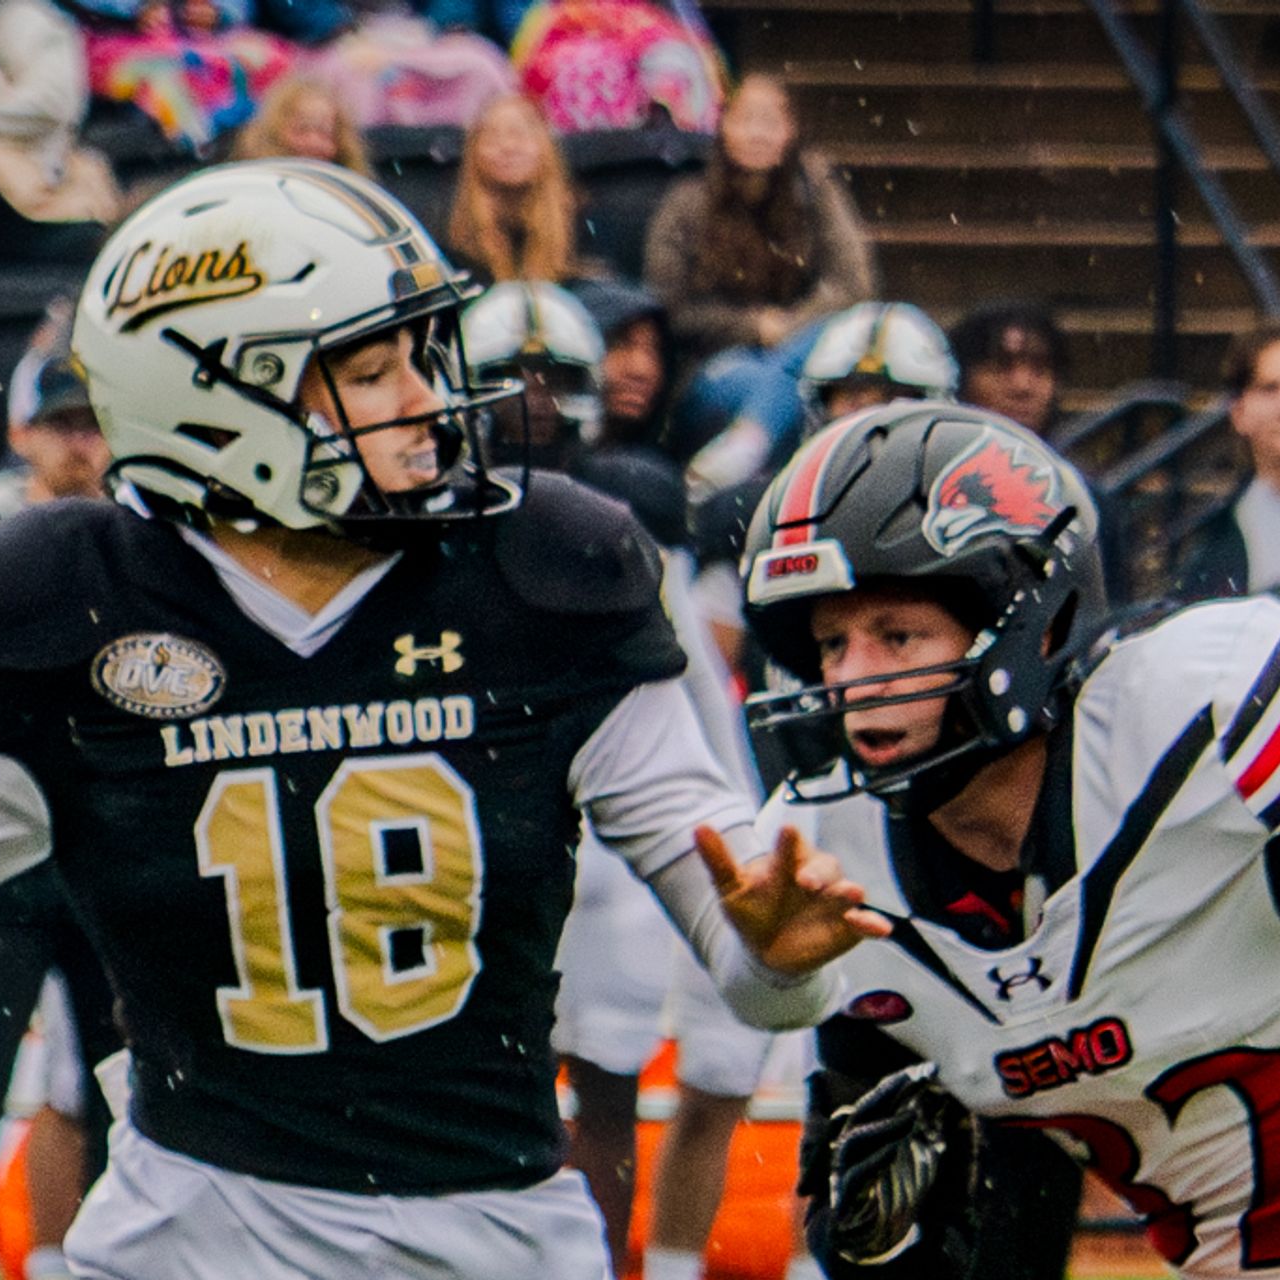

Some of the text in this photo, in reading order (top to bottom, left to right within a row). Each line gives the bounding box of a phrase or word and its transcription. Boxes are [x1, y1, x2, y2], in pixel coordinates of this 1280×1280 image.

[106, 239, 262, 333] Lions
[160, 695, 475, 767] LINDENWOOD
[193, 752, 484, 1054] 18
[994, 1015, 1134, 1098] SEMO
